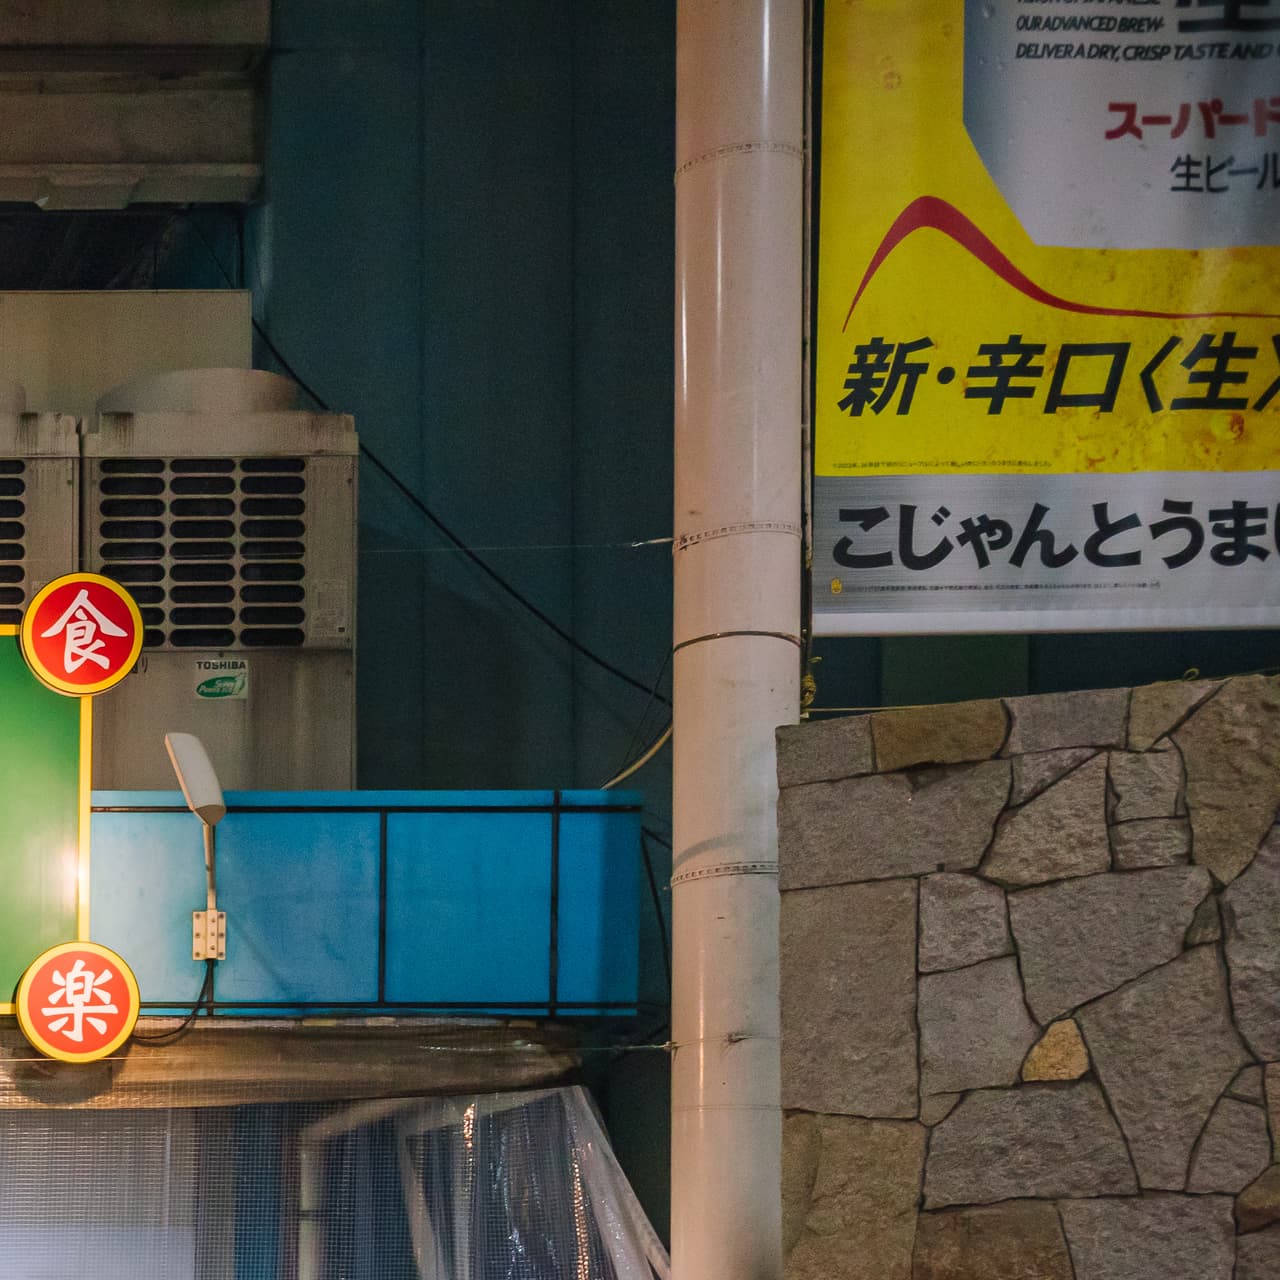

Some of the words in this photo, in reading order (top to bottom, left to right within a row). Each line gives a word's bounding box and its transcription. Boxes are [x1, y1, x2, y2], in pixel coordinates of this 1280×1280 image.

[1016, 15, 1042, 31] OUR
[1042, 15, 1117, 32] ADVANCED
[1016, 43, 1074, 60] DELIVER
[1123, 44, 1172, 62] CRISP
[1173, 43, 1230, 60] TASTE
[40, 588, 130, 675] 食
[196, 661, 246, 670] TOSHIBA
[41, 957, 121, 1044] 楽
